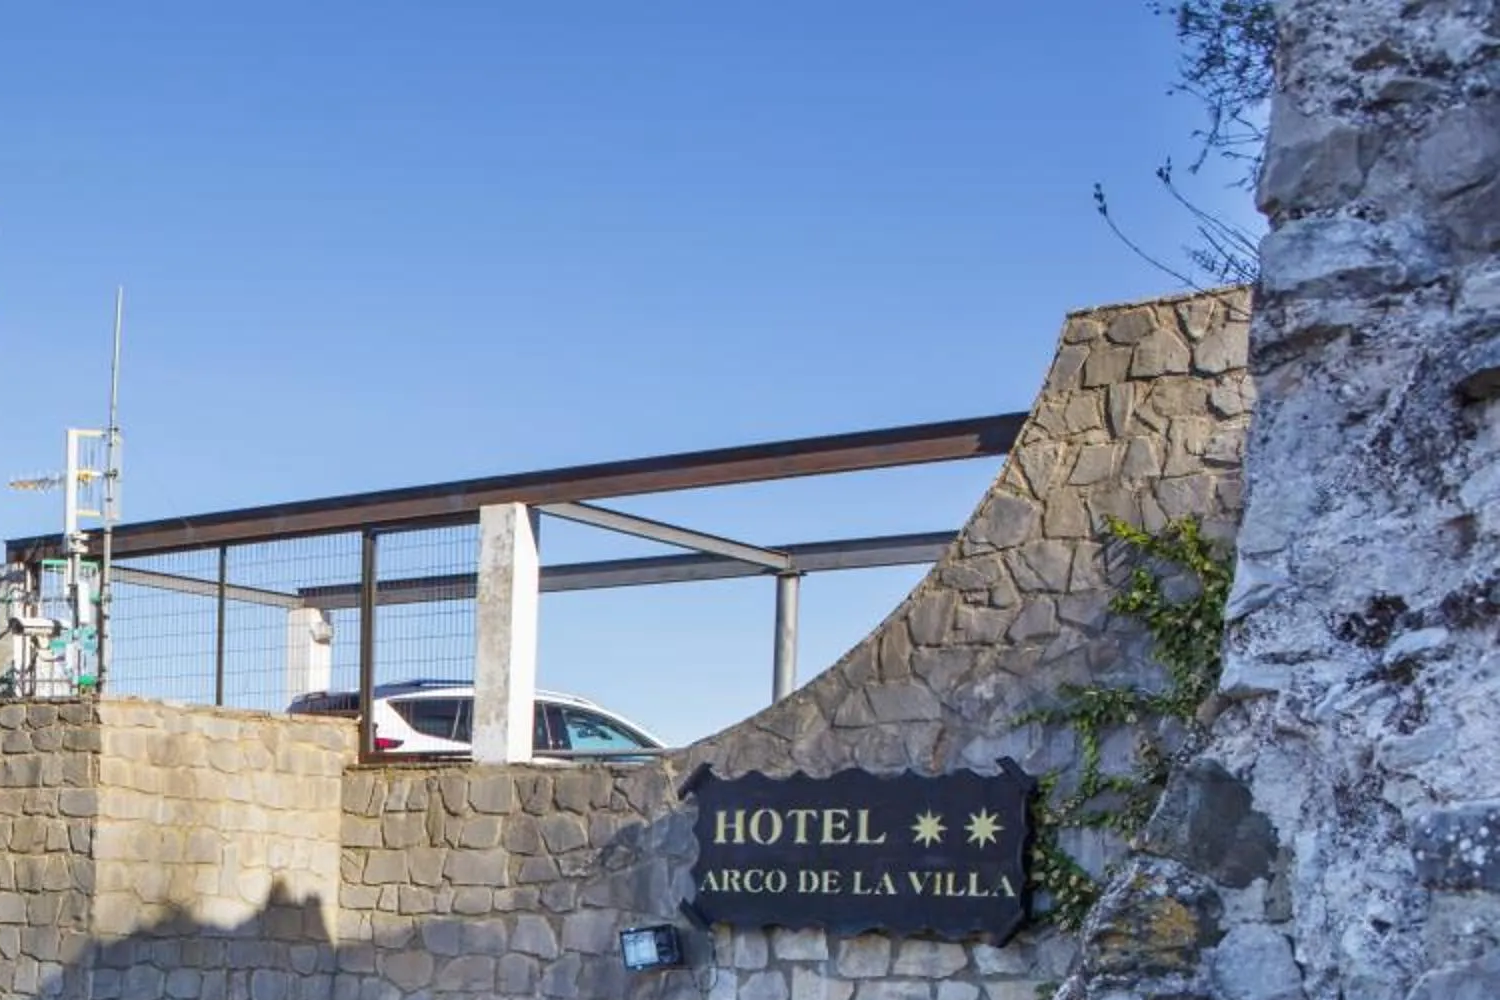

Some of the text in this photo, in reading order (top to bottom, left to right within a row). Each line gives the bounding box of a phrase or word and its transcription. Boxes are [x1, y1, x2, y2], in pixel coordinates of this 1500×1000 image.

[713, 808, 887, 845] HOTEL
[700, 869, 1016, 898] ARCO DE LA VILLA
